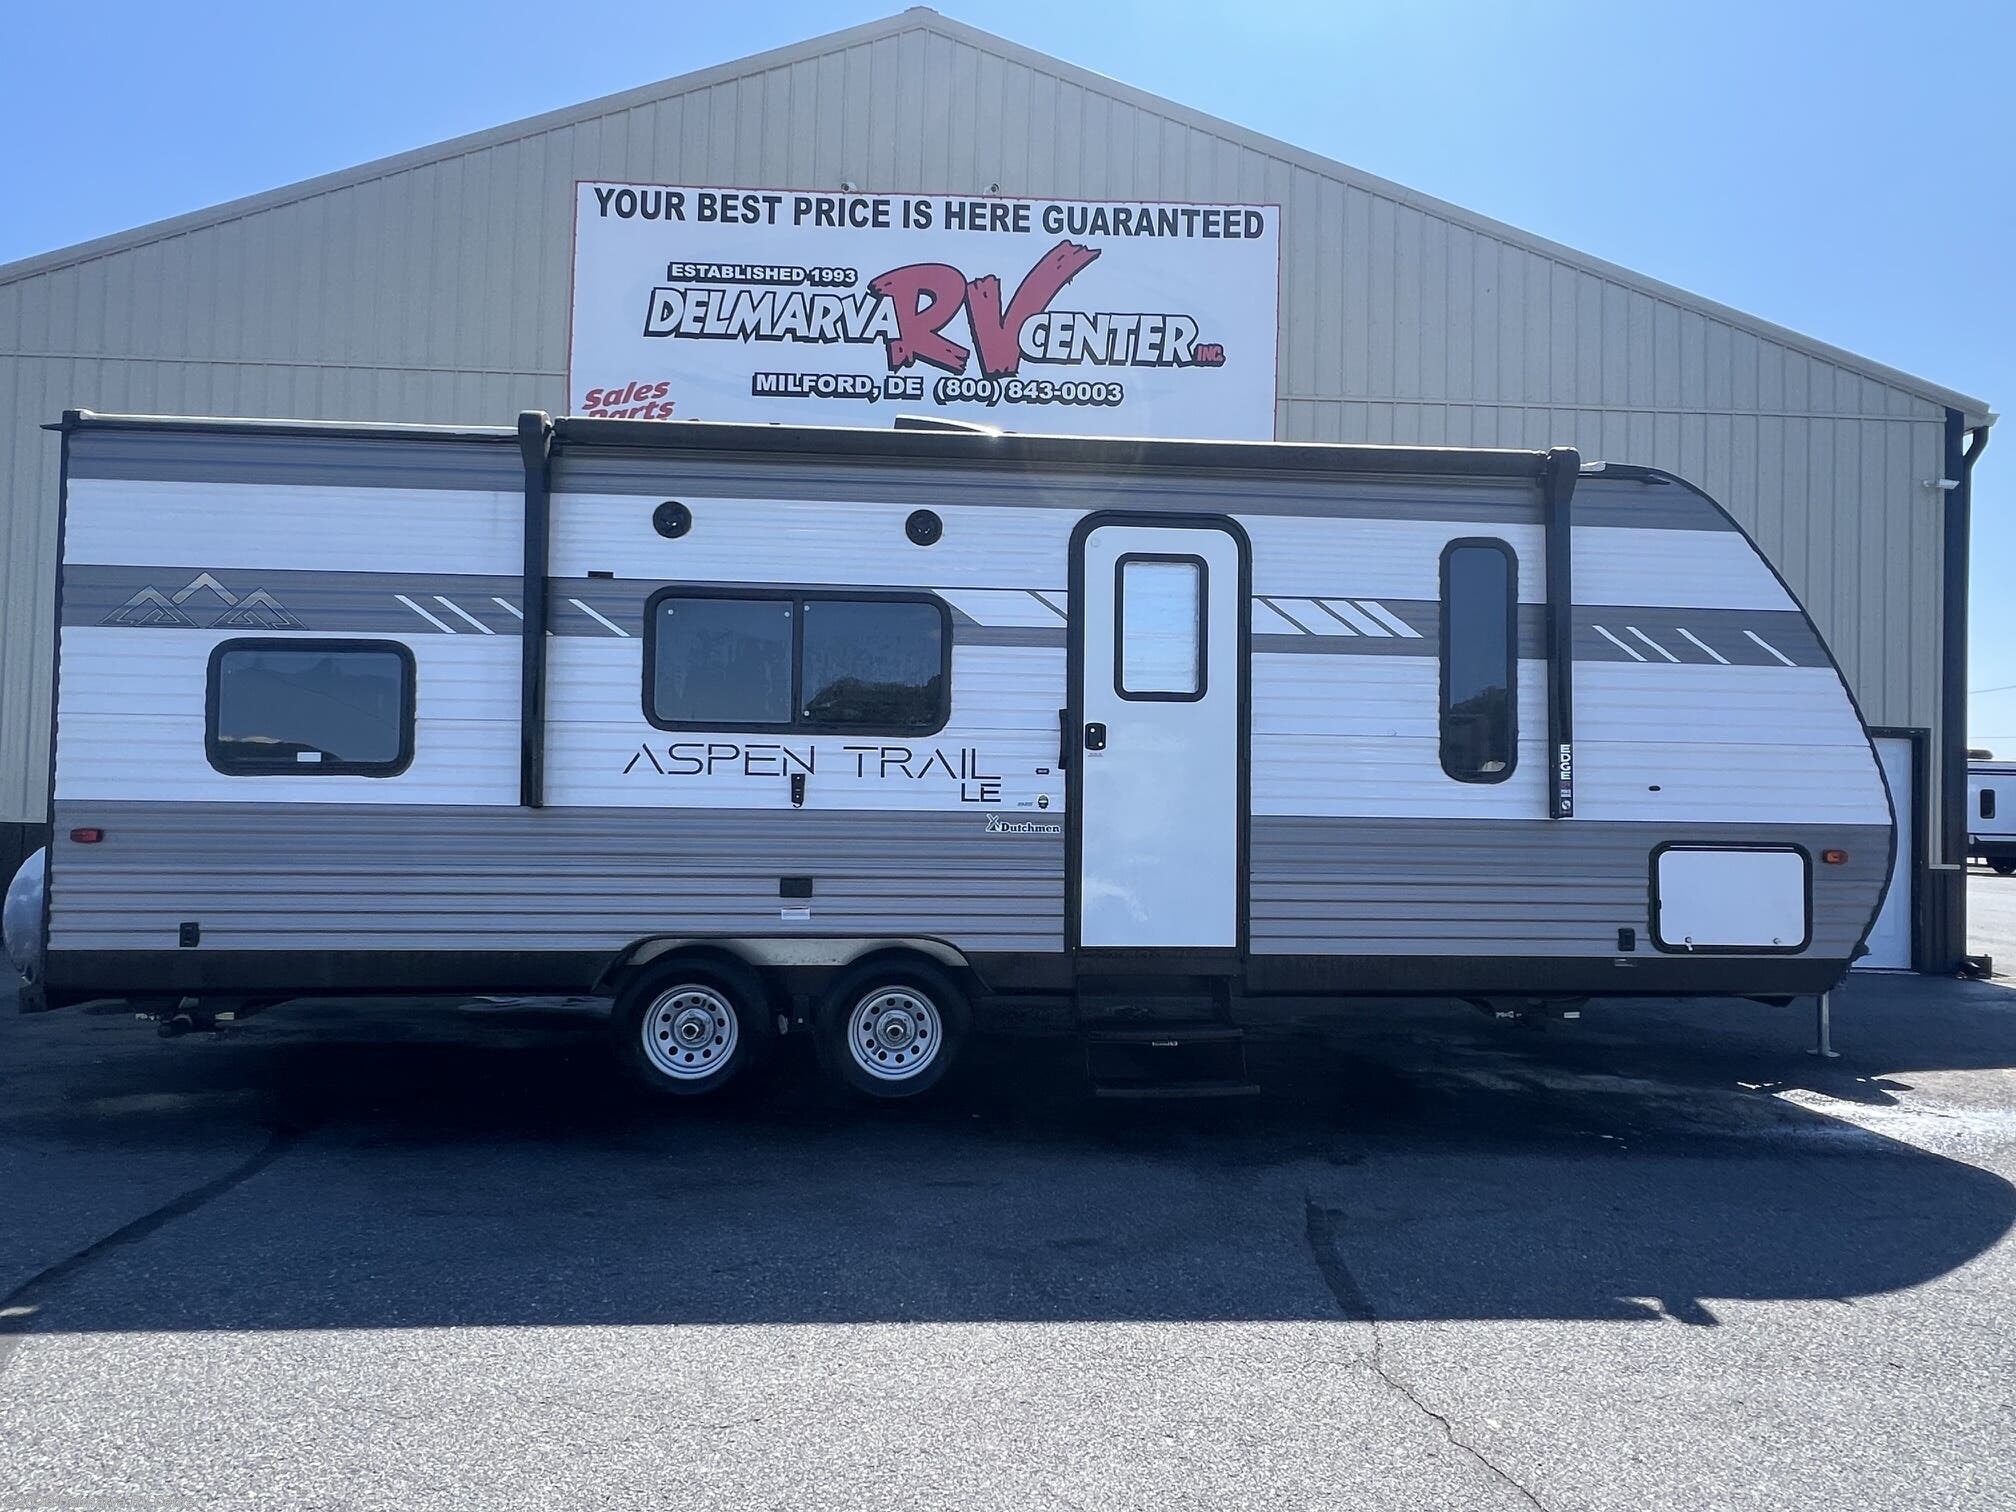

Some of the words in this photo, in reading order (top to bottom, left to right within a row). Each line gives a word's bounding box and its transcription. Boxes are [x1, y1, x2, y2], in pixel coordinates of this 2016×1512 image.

[594, 188, 686, 221] YOUR
[698, 193, 782, 224] BEST
[794, 198, 890, 228] PRICE
[903, 200, 932, 229] IS
[945, 201, 1031, 232] HERE
[1043, 205, 1264, 239] GUARANTEED
[668, 262, 807, 286] ESTABLISHED
[809, 267, 858, 287] 1993
[644, 287, 902, 344] DELMARVA
[867, 239, 1102, 379] RV
[1018, 312, 1199, 367] CENTER
[581, 381, 671, 410] Sales
[752, 372, 882, 403] MILFORD,
[884, 376, 924, 400] DE
[933, 377, 1002, 406] (800)
[1004, 380, 1124, 406] 843-0003
[622, 743, 815, 777] ASPEN
[843, 746, 1001, 780] TRAIL
[1560, 744, 1572, 780] EDGE
[960, 783, 1002, 803] LE
[1001, 823, 1060, 833] Dutchmen
